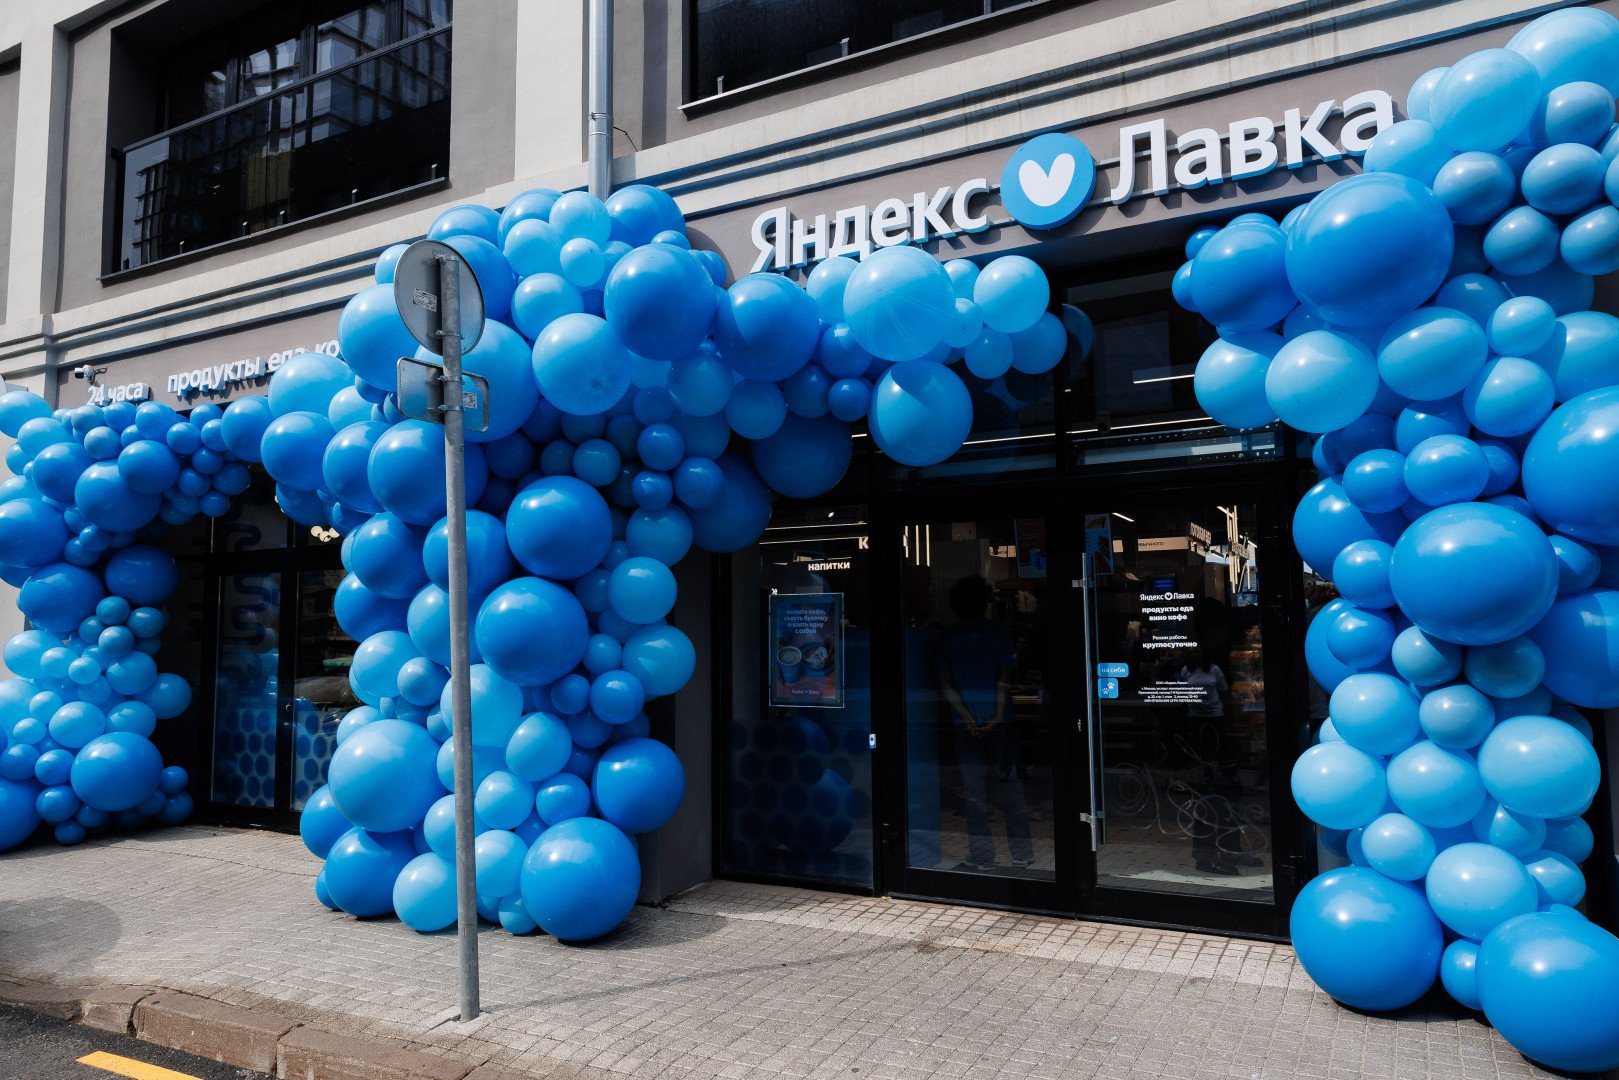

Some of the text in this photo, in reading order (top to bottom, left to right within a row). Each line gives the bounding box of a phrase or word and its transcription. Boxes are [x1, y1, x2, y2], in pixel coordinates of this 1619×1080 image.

[750, 89, 1395, 273] Яндекс Лавка
[167, 357, 265, 398] продукты
[86, 382, 147, 406] 24 часа
[808, 562, 850, 571] напитки
[1140, 592, 1194, 601] Яндекс Лавка
[1142, 606, 1179, 614] продукты
[1168, 613, 1187, 621] кофе
[1142, 641, 1198, 649] круглосуточно
